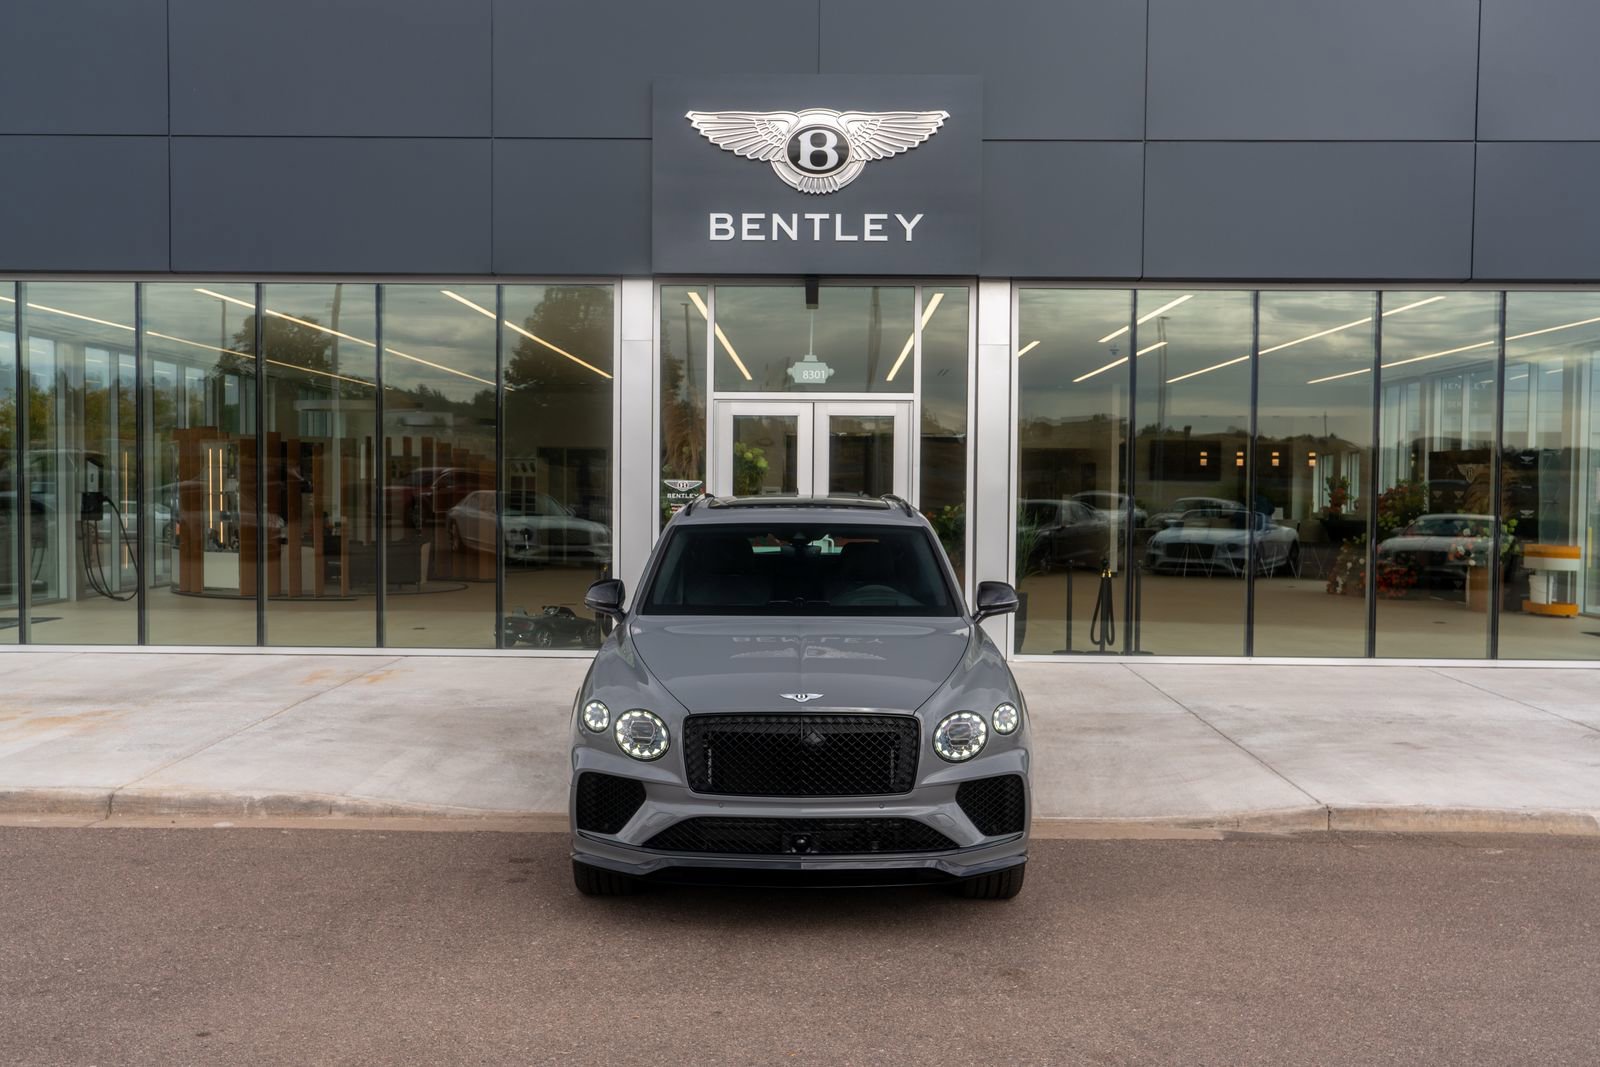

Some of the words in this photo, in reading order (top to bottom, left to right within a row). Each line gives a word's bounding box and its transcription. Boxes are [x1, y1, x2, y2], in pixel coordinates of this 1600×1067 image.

[798, 129, 838, 171] B
[708, 213, 924, 242] BENTLEY
[802, 370, 825, 379] 8301
